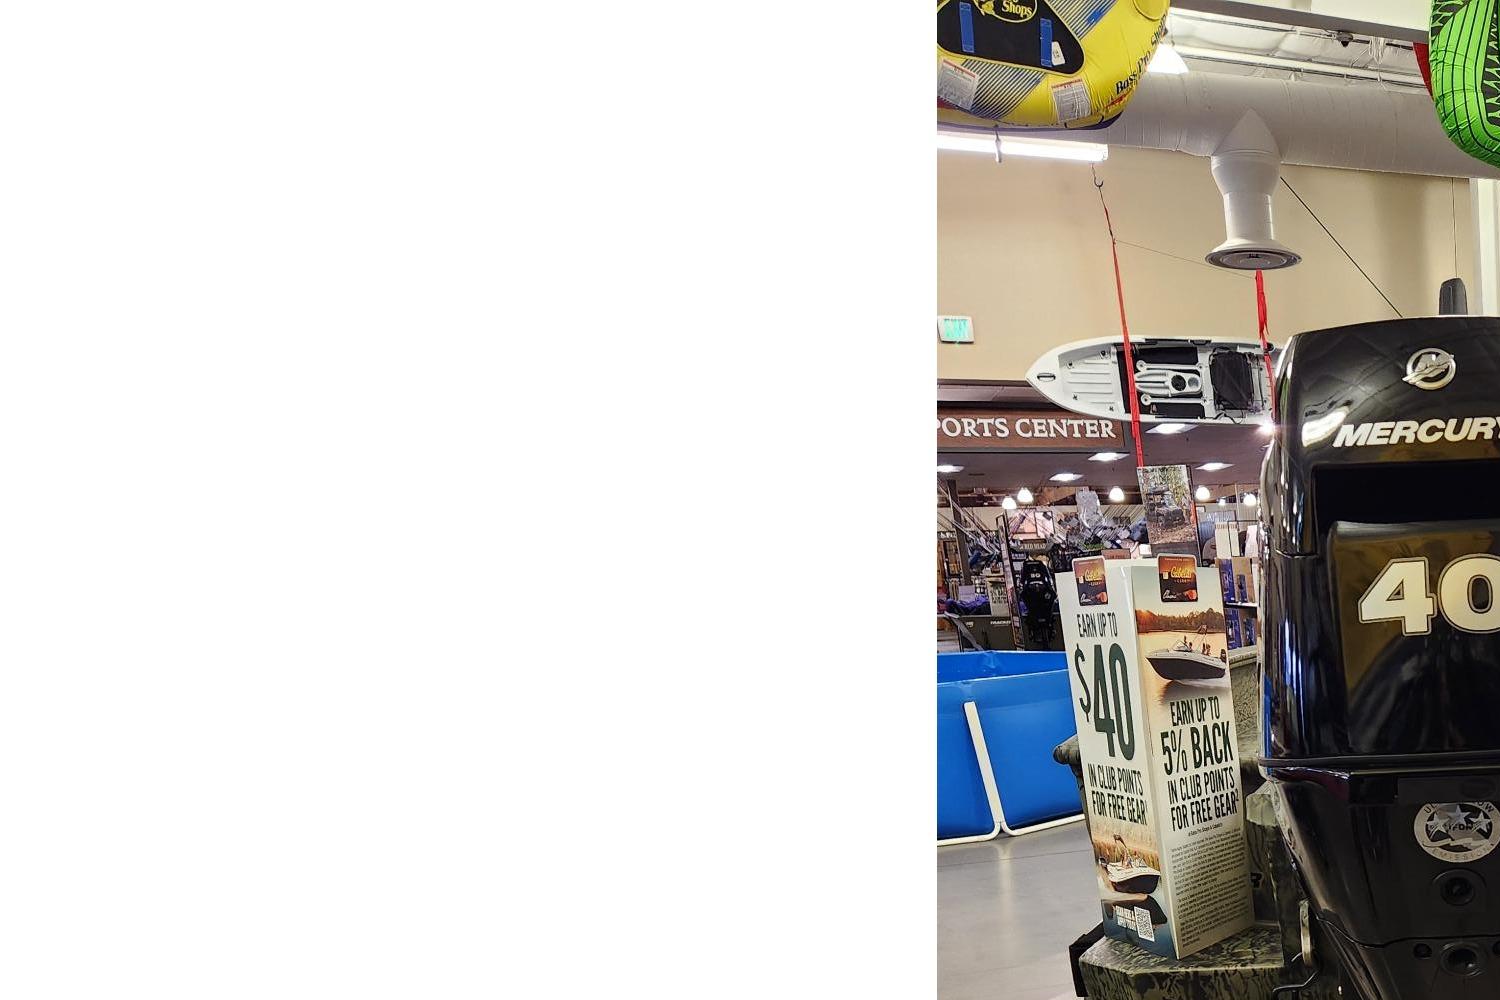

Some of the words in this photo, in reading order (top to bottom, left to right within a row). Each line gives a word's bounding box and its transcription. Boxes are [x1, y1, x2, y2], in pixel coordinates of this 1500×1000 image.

[1002, 0, 1033, 18] Shops
[1115, 71, 1138, 95] Bass
[1015, 417, 1117, 439] CENTER
[1076, 613, 1098, 638] EARN
[1099, 612, 1107, 637] UP
[1109, 611, 1118, 637] TO
[1074, 642, 1135, 761] $40
[1170, 700, 1194, 727] EARN
[1195, 698, 1207, 724] UP
[1208, 695, 1221, 721] TO
[1161, 728, 1188, 776] 5%
[1190, 720, 1233, 770] BACK
[1087, 763, 1098, 787] IN
[1099, 765, 1117, 791] CLUB
[1118, 768, 1144, 796] POINTS
[1167, 780, 1179, 805] IN
[1179, 774, 1201, 802] CLUB
[1204, 766, 1235, 796] POINTS
[1091, 790, 1107, 816] FOR
[1108, 793, 1127, 821] FREE
[1170, 804, 1190, 831] FOR
[1190, 800, 1213, 826] FREE
